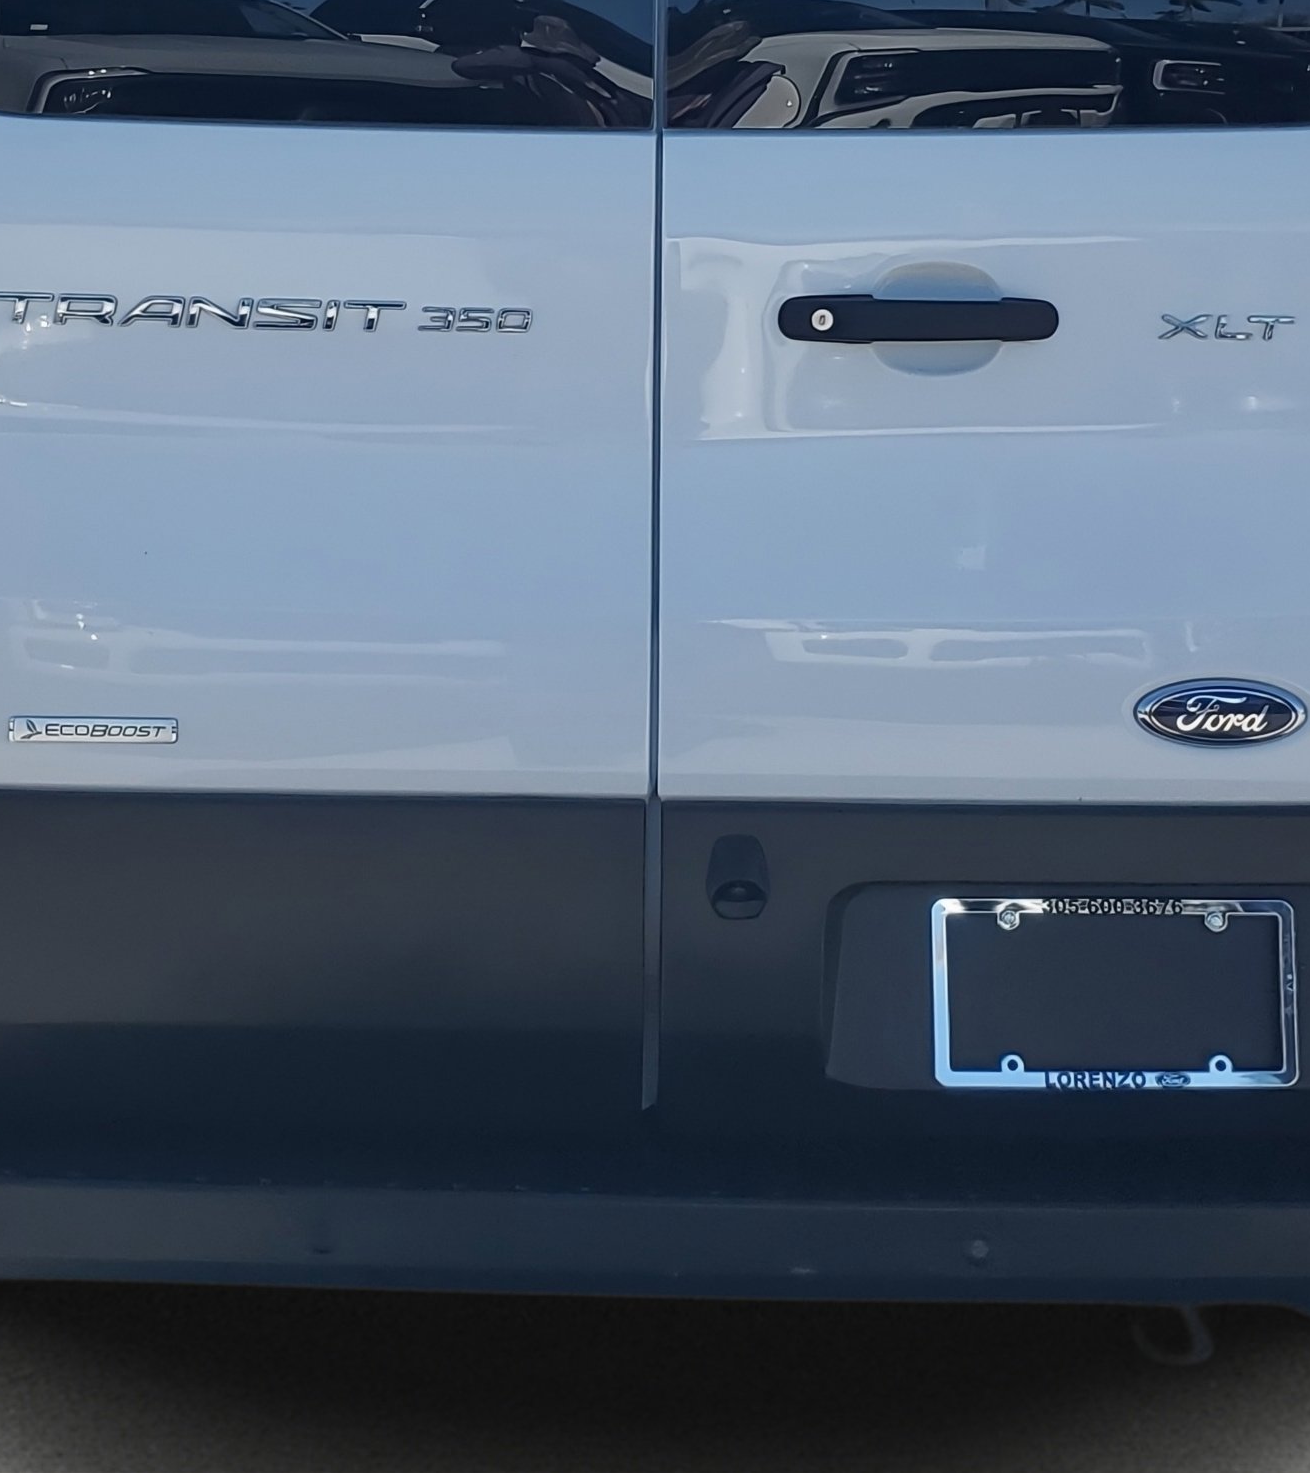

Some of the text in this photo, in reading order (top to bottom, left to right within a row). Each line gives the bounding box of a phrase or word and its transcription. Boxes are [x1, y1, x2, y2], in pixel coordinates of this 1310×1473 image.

[417, 305, 534, 333] 350
[1157, 313, 1296, 341] XLT
[1176, 694, 1268, 732] Ford
[1044, 1070, 1147, 1089] LORENZO
